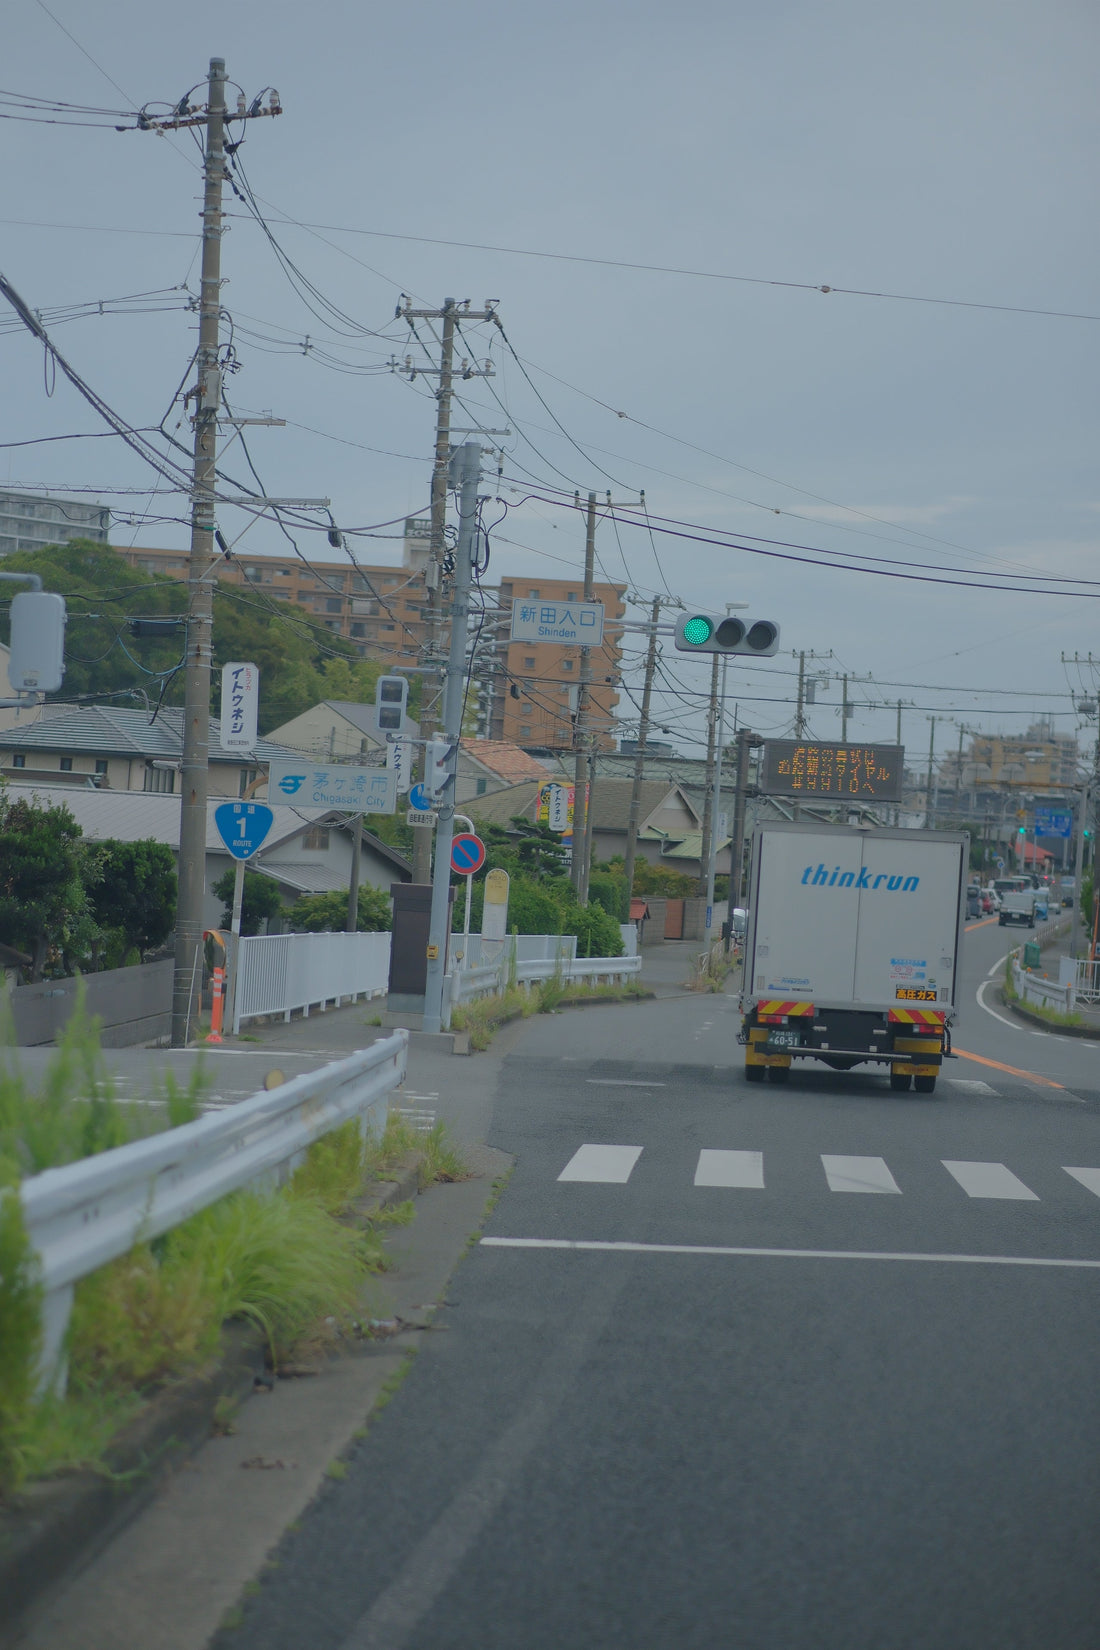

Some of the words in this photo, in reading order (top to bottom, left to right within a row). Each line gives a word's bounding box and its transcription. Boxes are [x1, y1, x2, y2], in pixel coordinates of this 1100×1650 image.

[520, 606, 596, 627] 新田入口
[538, 626, 576, 638] Shinden
[231, 667, 244, 734] イトウネジ
[313, 792, 360, 805] Chigasaki
[366, 795, 385, 808] City
[236, 817, 246, 838] 1
[800, 863, 920, 892] thinkrun
[896, 989, 936, 1001] 高圧ガス
